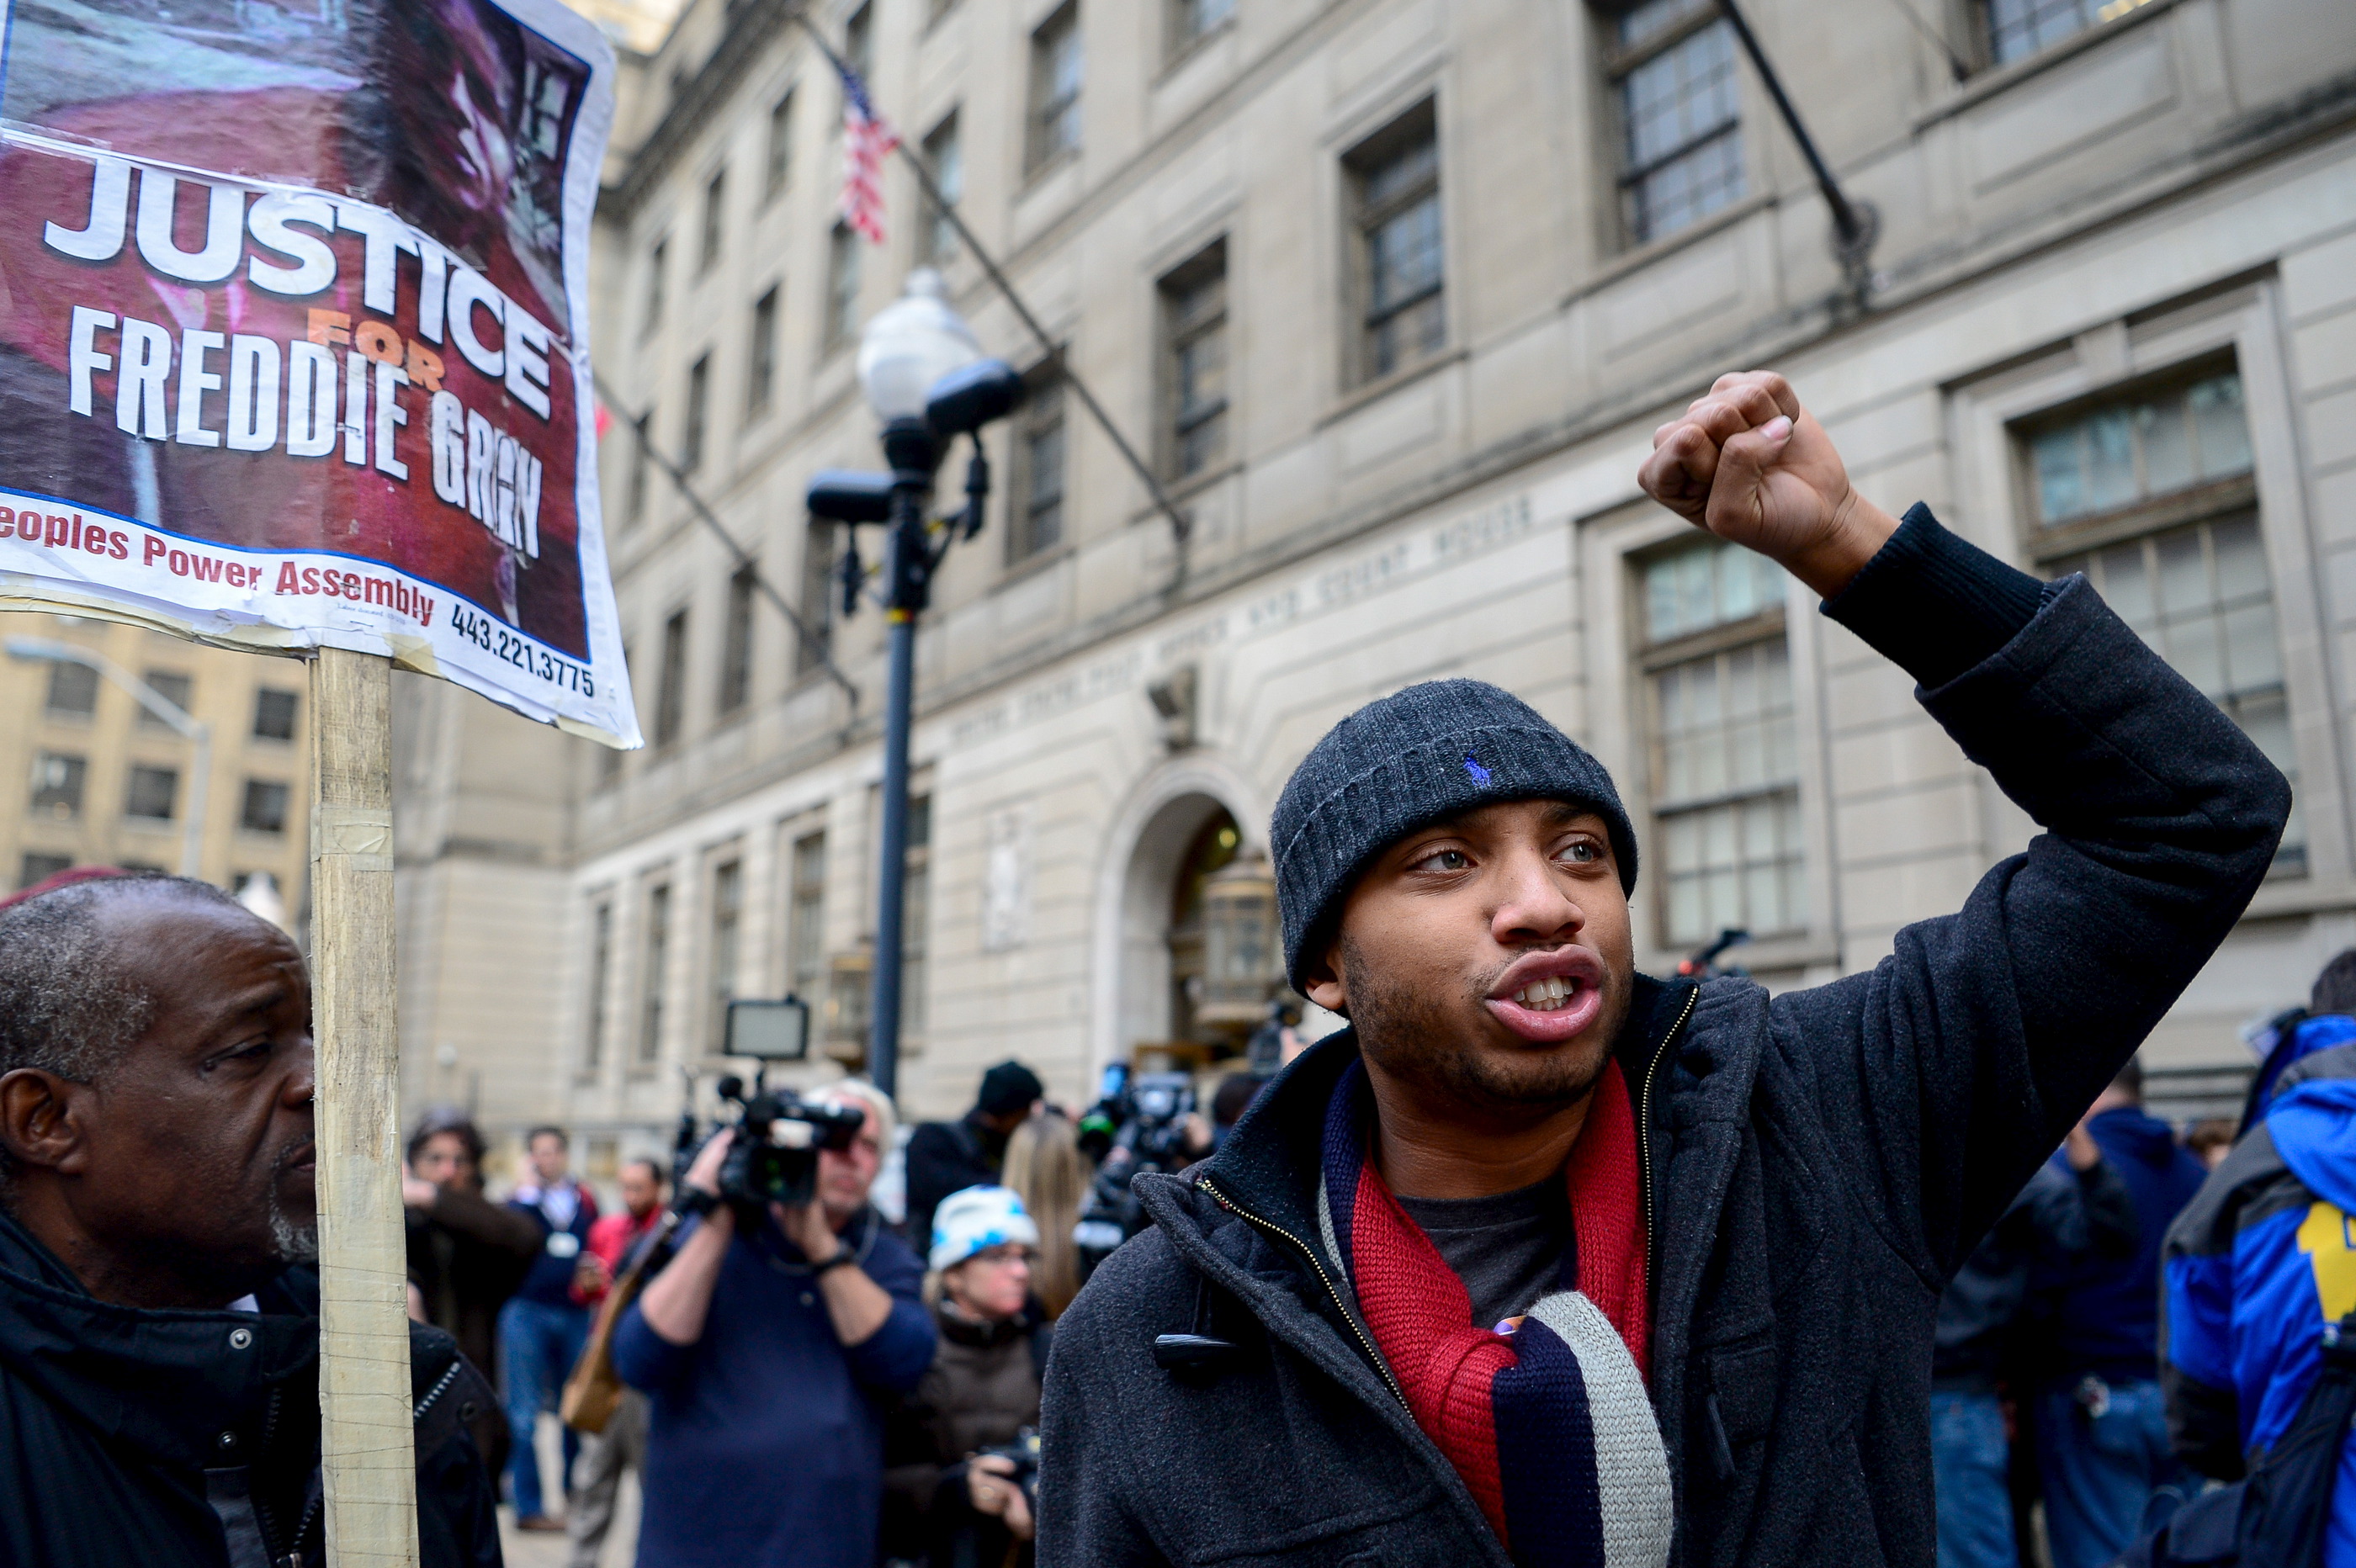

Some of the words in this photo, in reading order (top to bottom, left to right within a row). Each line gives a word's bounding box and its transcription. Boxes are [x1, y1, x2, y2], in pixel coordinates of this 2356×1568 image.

[44, 156, 551, 420] JUSTICE
[68, 305, 410, 480] FREDDIE
[307, 308, 445, 393] FOR
[143, 533, 263, 591] Power
[275, 561, 435, 628] Assembly
[451, 603, 595, 698] 443.221.3775
